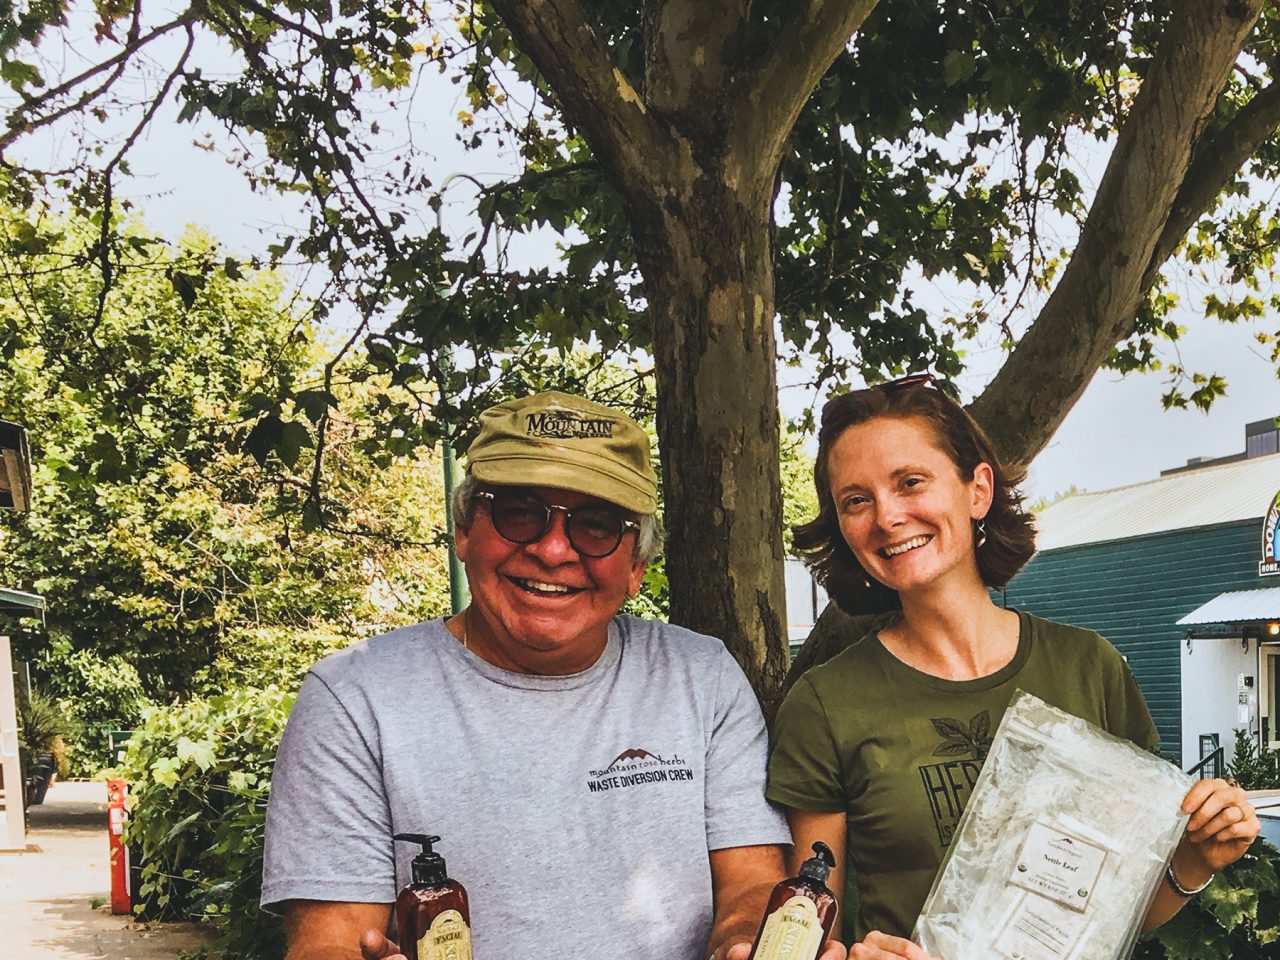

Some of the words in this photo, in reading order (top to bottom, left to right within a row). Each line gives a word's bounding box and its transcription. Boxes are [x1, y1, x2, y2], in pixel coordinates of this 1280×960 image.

[589, 764, 637, 778] mountain
[639, 760, 658, 769] rose
[658, 754, 686, 766] herbs
[587, 776, 621, 792] WASTE
[622, 770, 668, 788] DIVERSION
[668, 768, 694, 781] CREW
[1062, 862, 1079, 872] Leaf
